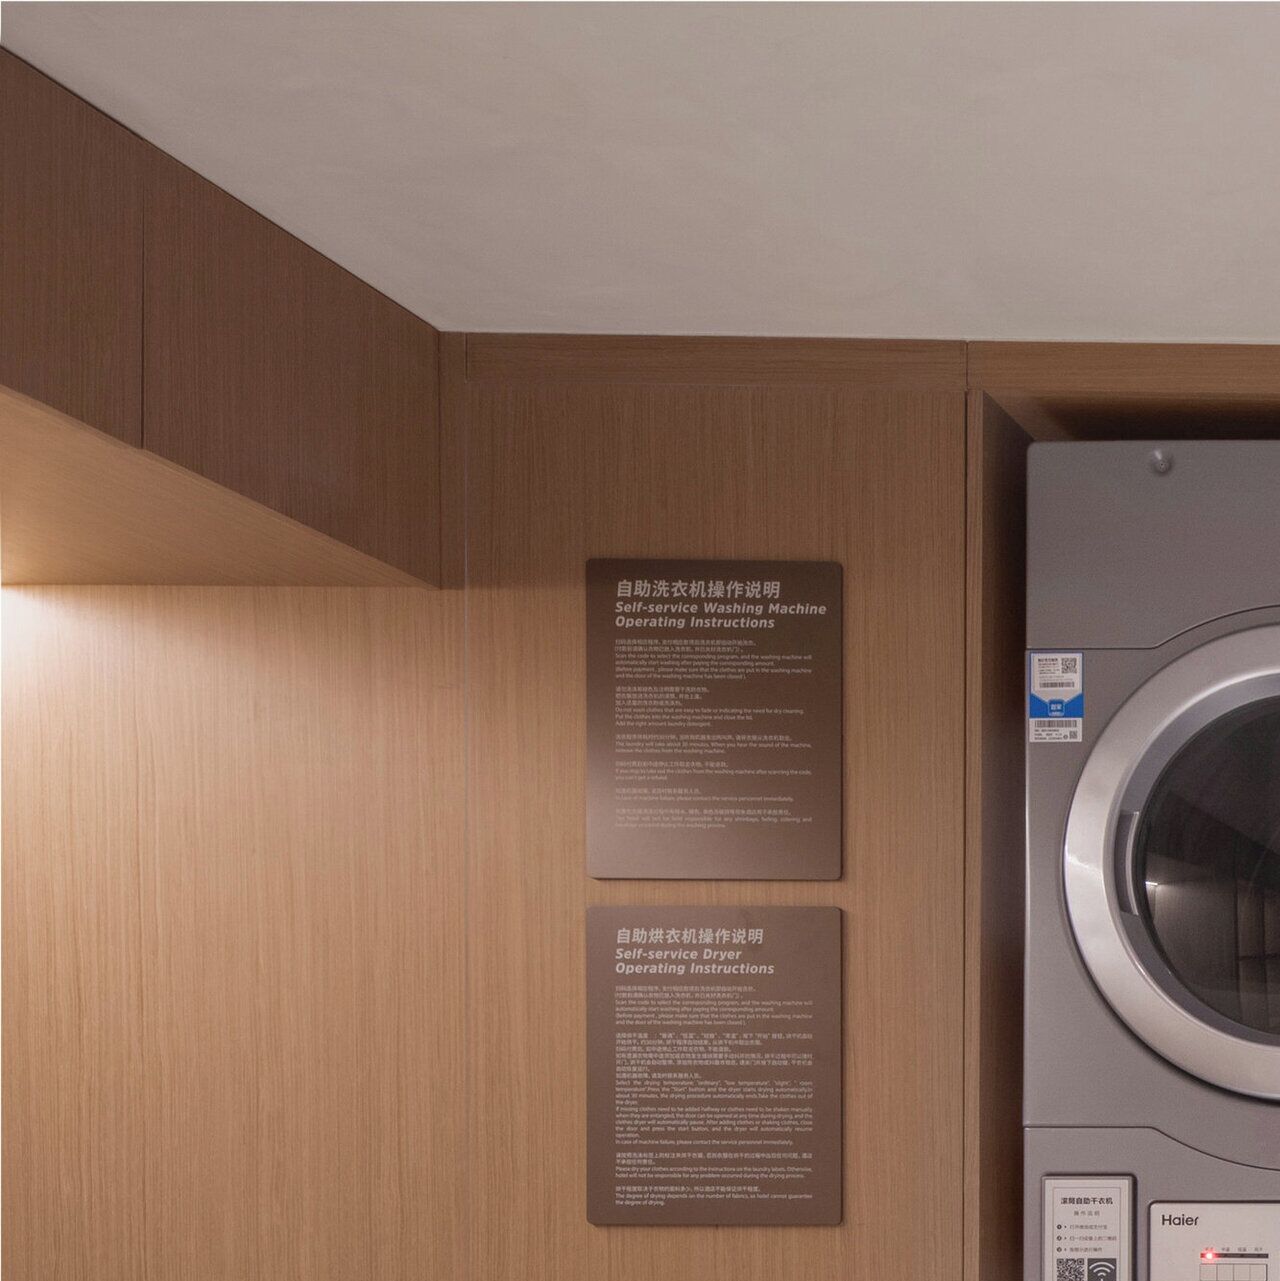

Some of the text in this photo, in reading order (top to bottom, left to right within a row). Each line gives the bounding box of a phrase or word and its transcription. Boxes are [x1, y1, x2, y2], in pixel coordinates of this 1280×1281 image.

[616, 580, 781, 599] 自助洗衣机操作说明
[615, 602, 826, 616] Self-service Washing Machine
[615, 616, 775, 629] Operating Instructions
[616, 928, 764, 944] 自助烘衣机操作说明
[615, 948, 742, 961] Self-service Dryer
[615, 962, 775, 975] Operating Instructions
[1161, 1214, 1199, 1226] Haier
